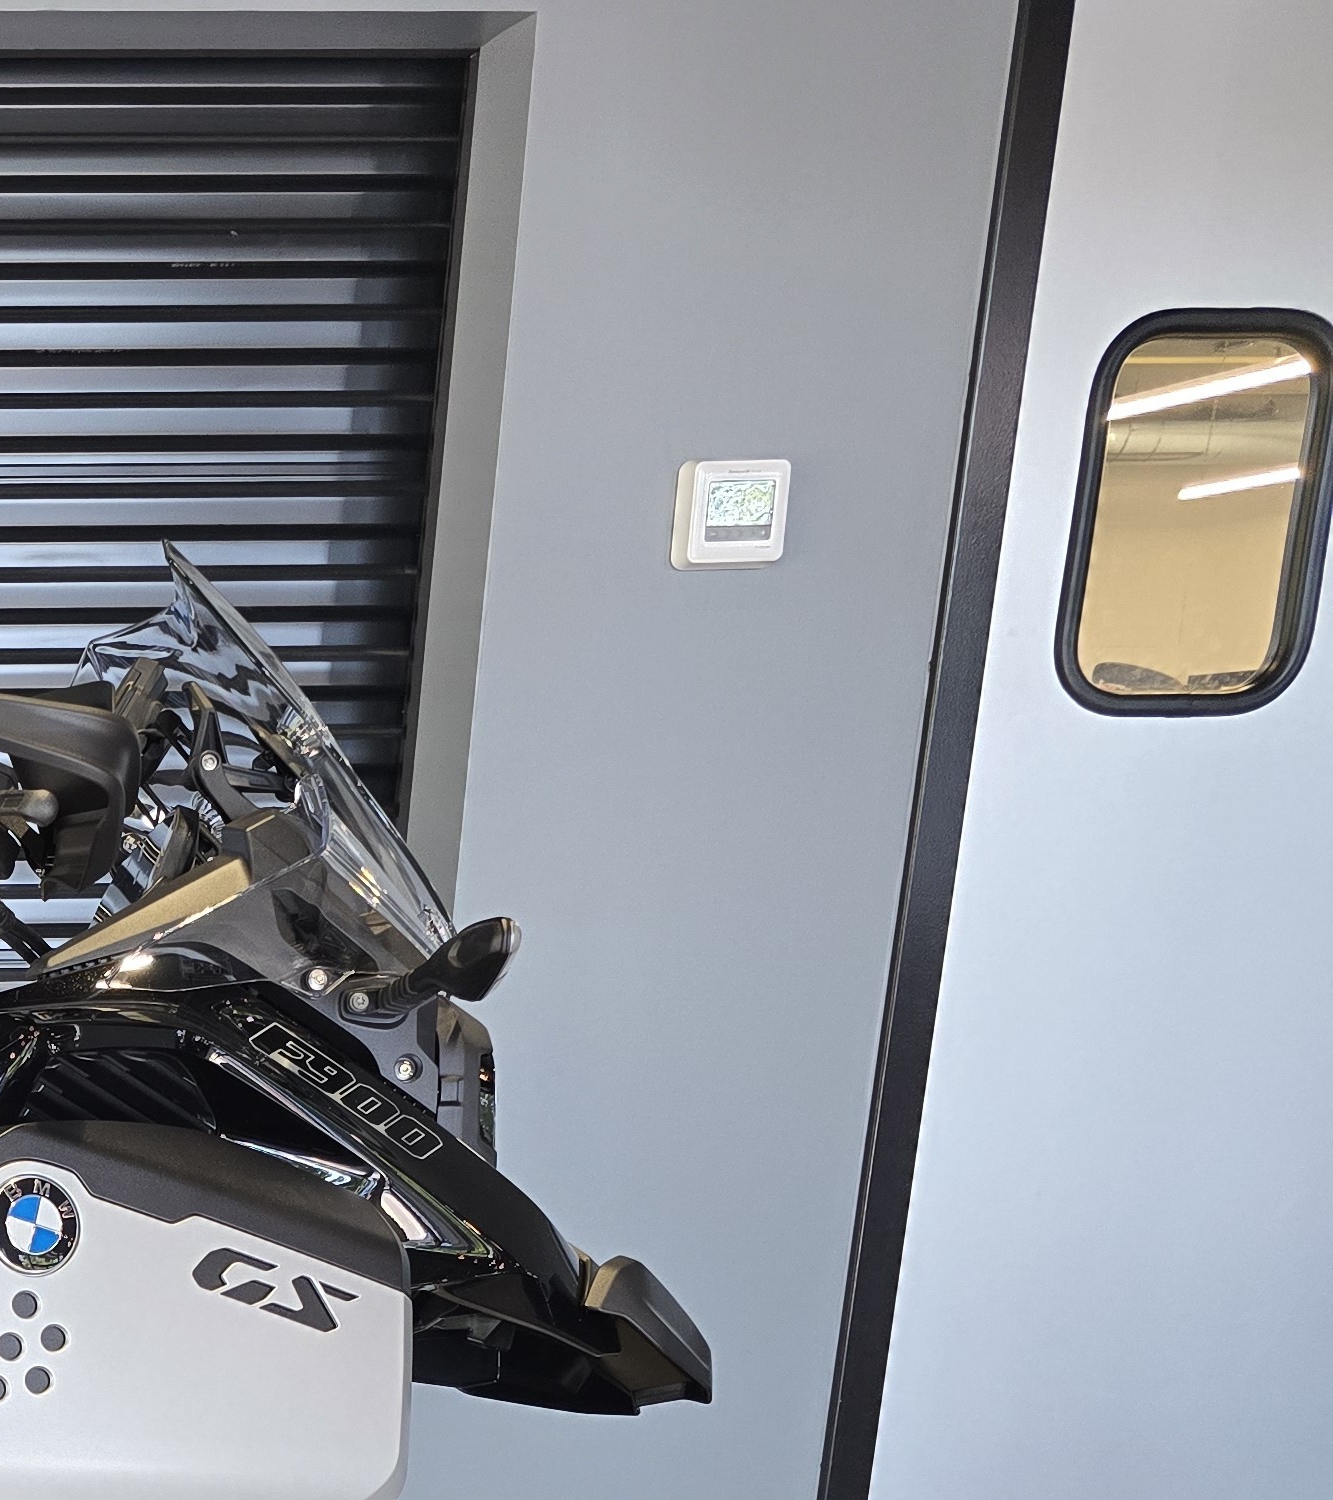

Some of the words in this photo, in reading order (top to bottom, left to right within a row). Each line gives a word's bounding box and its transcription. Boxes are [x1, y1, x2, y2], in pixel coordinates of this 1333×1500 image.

[247, 1021, 443, 1162] F900
[3, 1178, 75, 1220] BMW
[191, 1247, 360, 1333] GS
